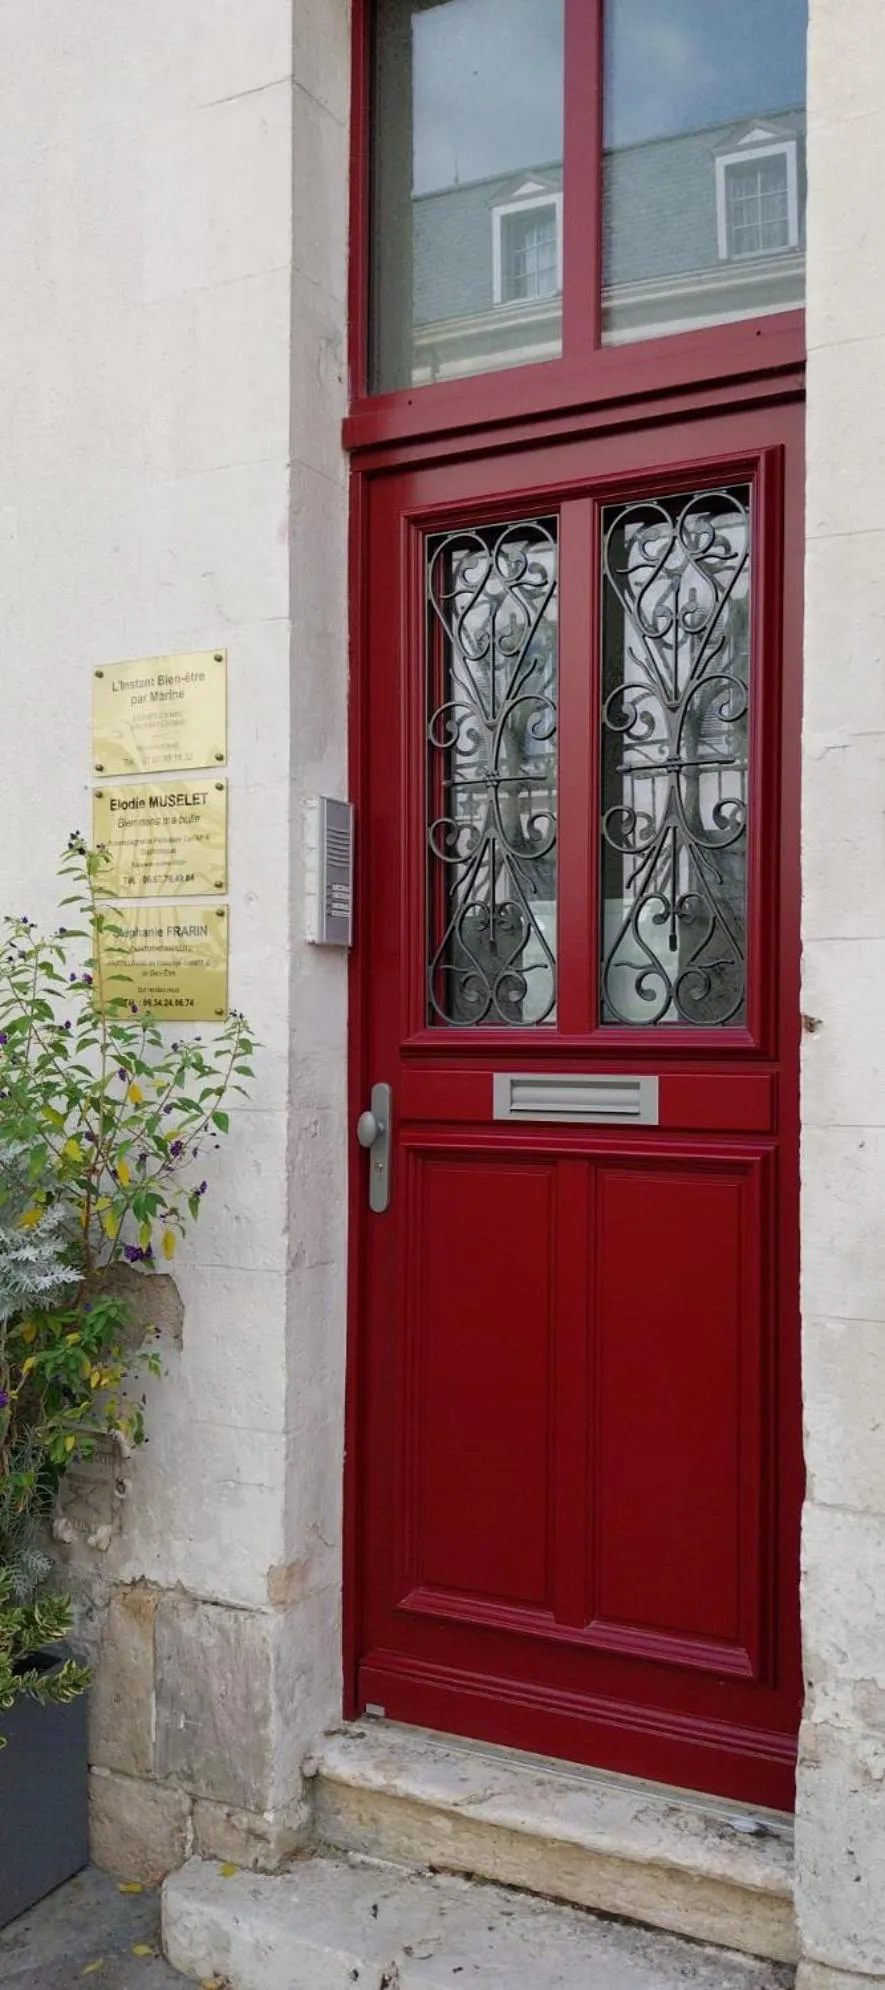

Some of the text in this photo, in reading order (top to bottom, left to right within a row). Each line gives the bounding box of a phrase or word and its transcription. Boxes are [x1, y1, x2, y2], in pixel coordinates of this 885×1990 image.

[110, 792, 208, 812] Elodie MUSELET
[167, 925, 208, 937] FRARIN
